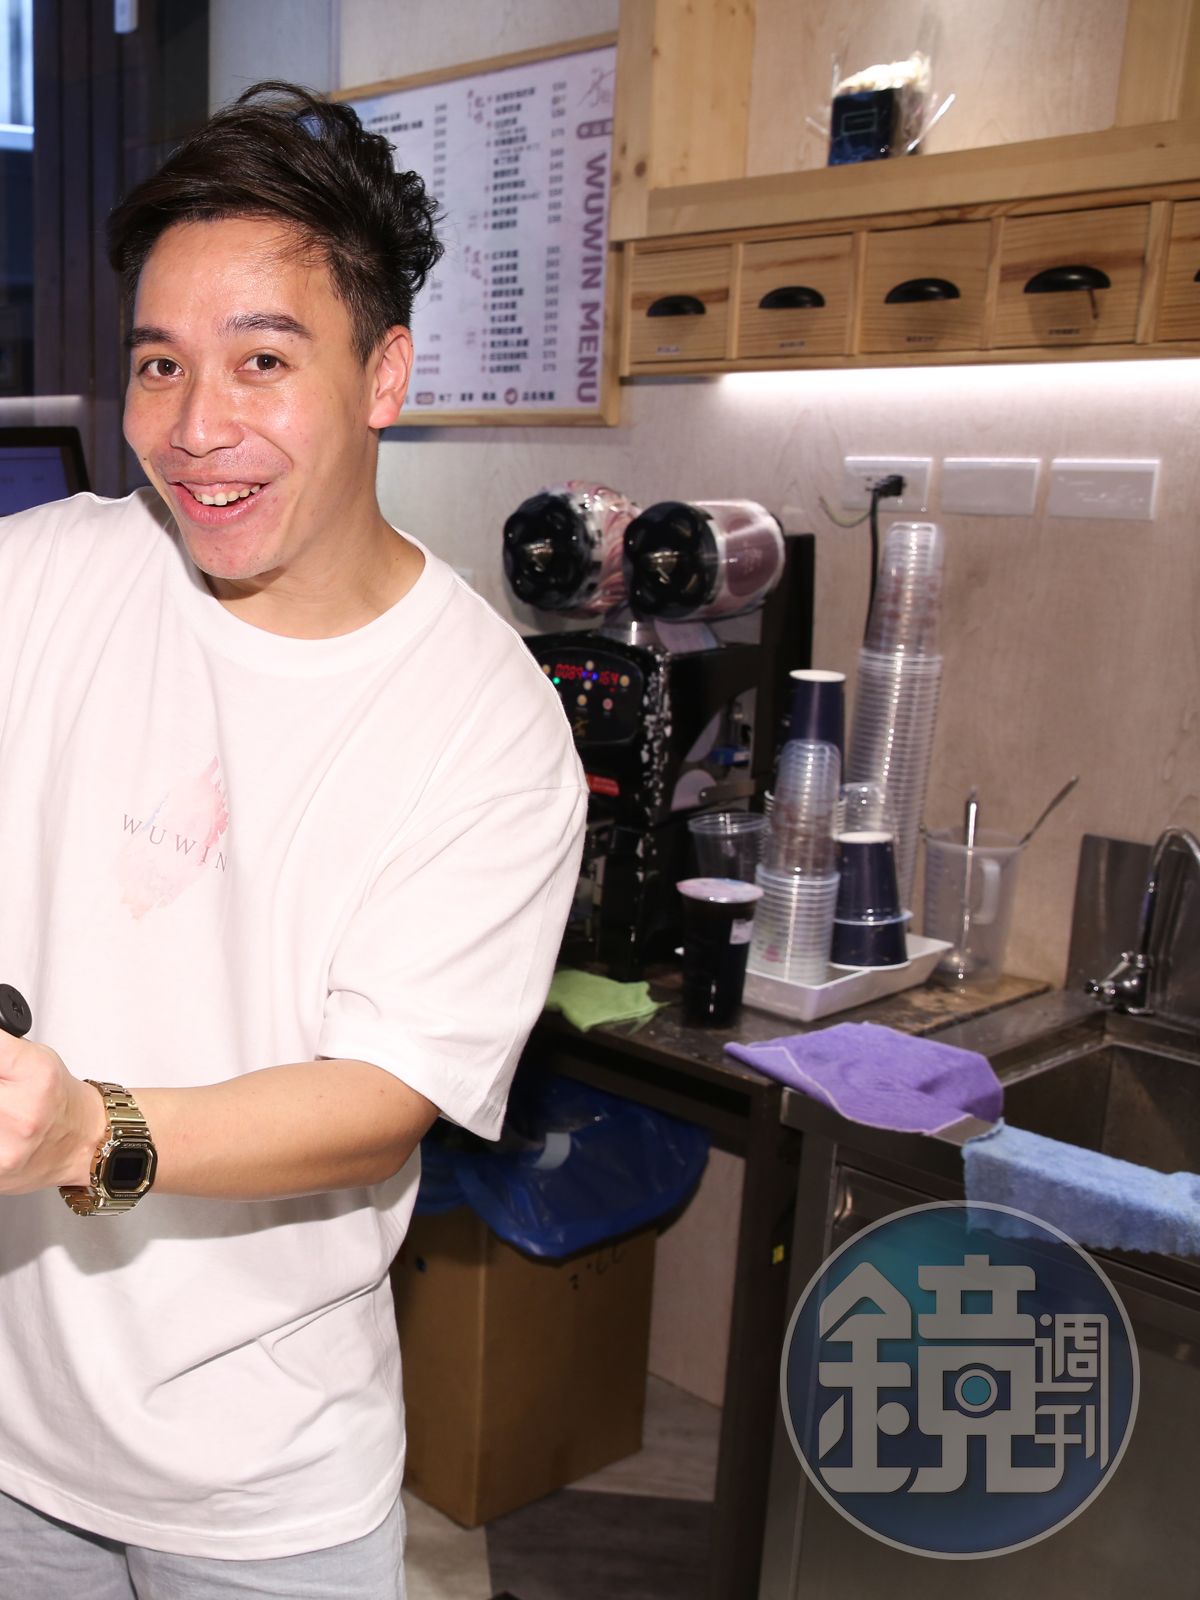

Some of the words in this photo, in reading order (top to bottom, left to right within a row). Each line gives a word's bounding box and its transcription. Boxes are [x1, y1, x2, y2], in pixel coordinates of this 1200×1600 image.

[581, 152, 607, 291] WUWIN
[576, 301, 601, 404] MENU
[122, 813, 228, 873] WUWIN
